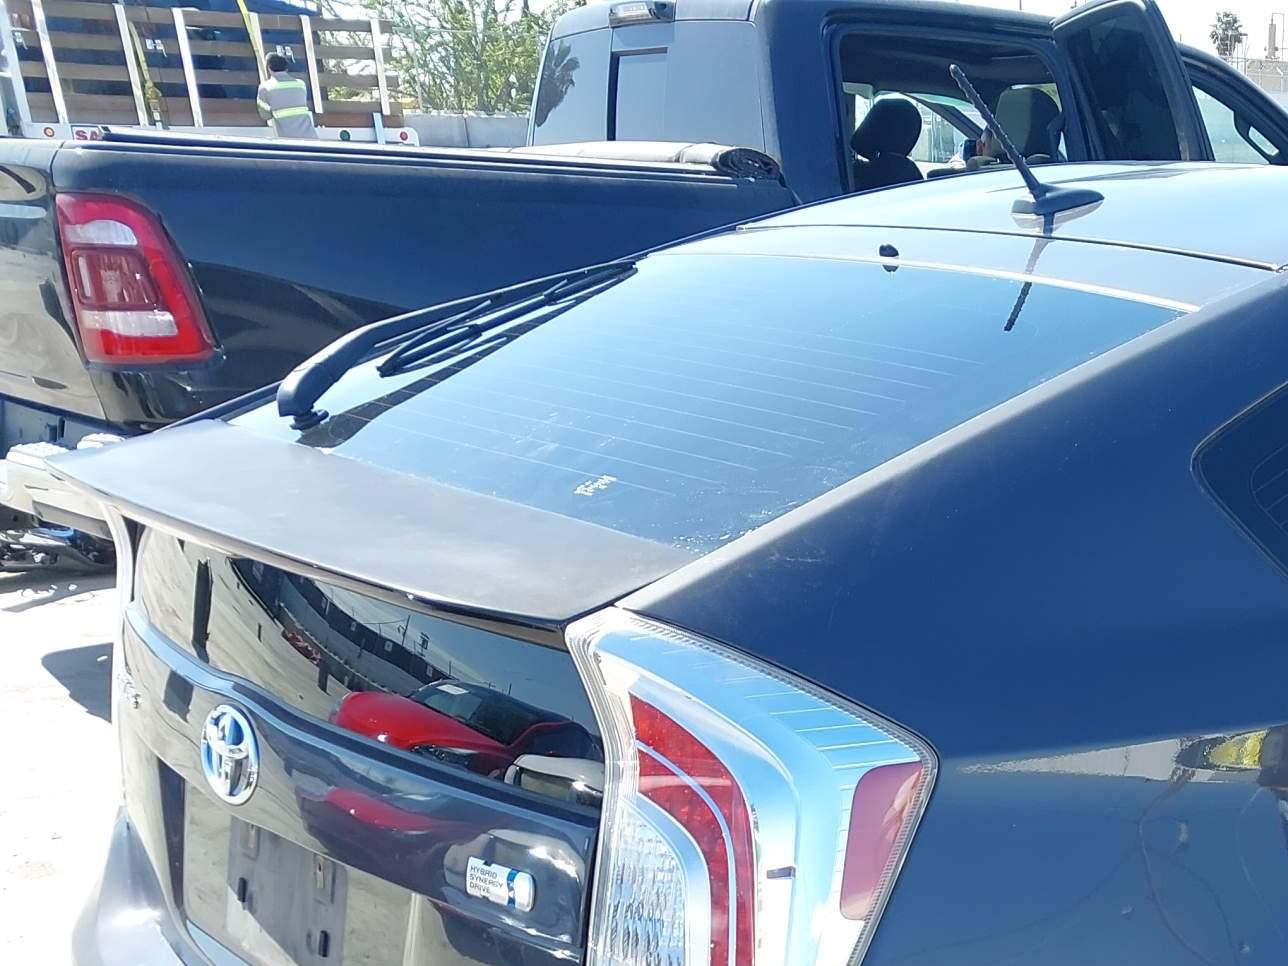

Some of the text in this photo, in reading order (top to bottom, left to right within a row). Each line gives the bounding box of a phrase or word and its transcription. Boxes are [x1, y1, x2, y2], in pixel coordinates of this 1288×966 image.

[470, 865, 498, 880] HYBRID
[469, 873, 504, 889] SYNERGY
[469, 881, 491, 894] DRIVE
